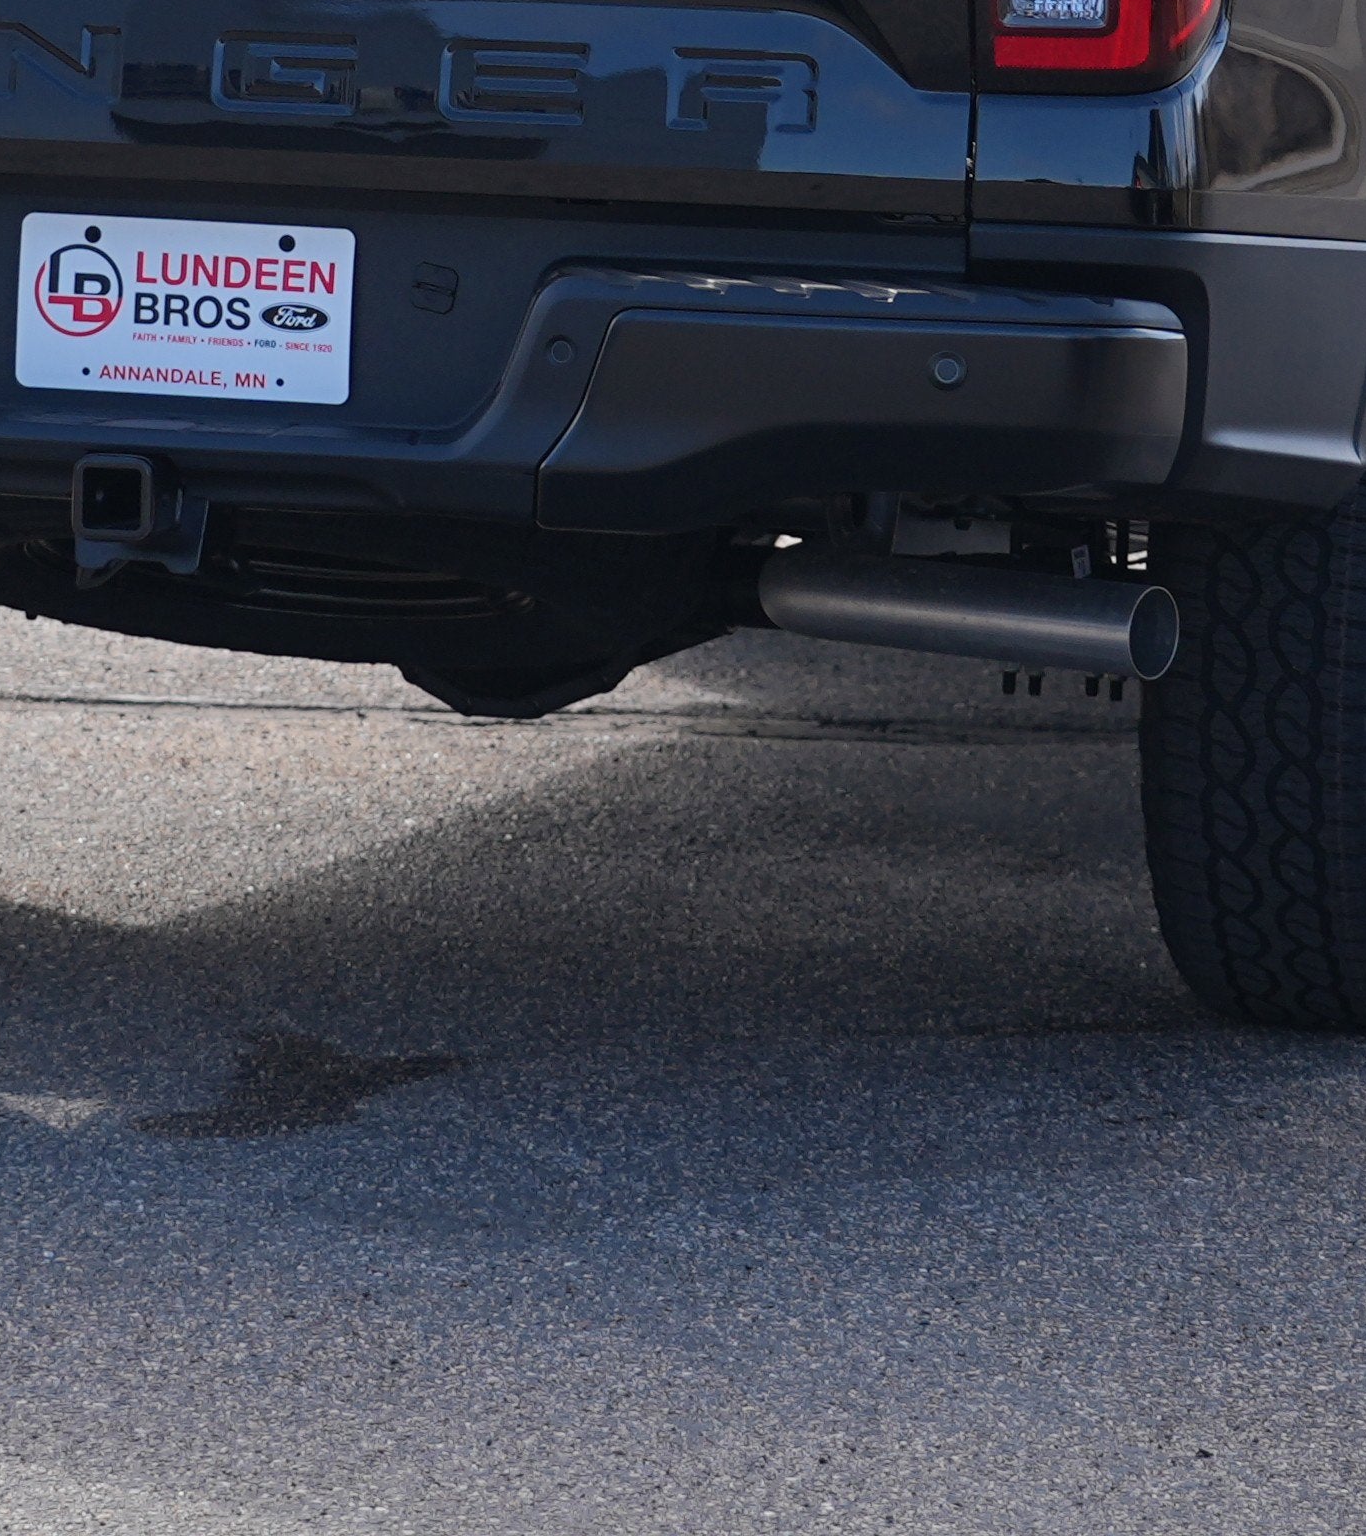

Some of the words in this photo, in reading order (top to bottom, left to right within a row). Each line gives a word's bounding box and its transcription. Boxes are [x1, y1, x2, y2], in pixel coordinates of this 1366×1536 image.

[135, 250, 336, 295] LUNDEEN
[133, 292, 251, 331] BROS
[272, 304, 317, 330] Ford
[132, 332, 157, 342] FAITH
[167, 334, 197, 345] FAMILY
[208, 337, 244, 347] FRIENDS
[254, 339, 277, 349] FORD
[285, 342, 310, 352] SINCE
[313, 343, 333, 353] 1920
[99, 364, 228, 390] ANNANDALE,
[235, 373, 266, 390] MN
